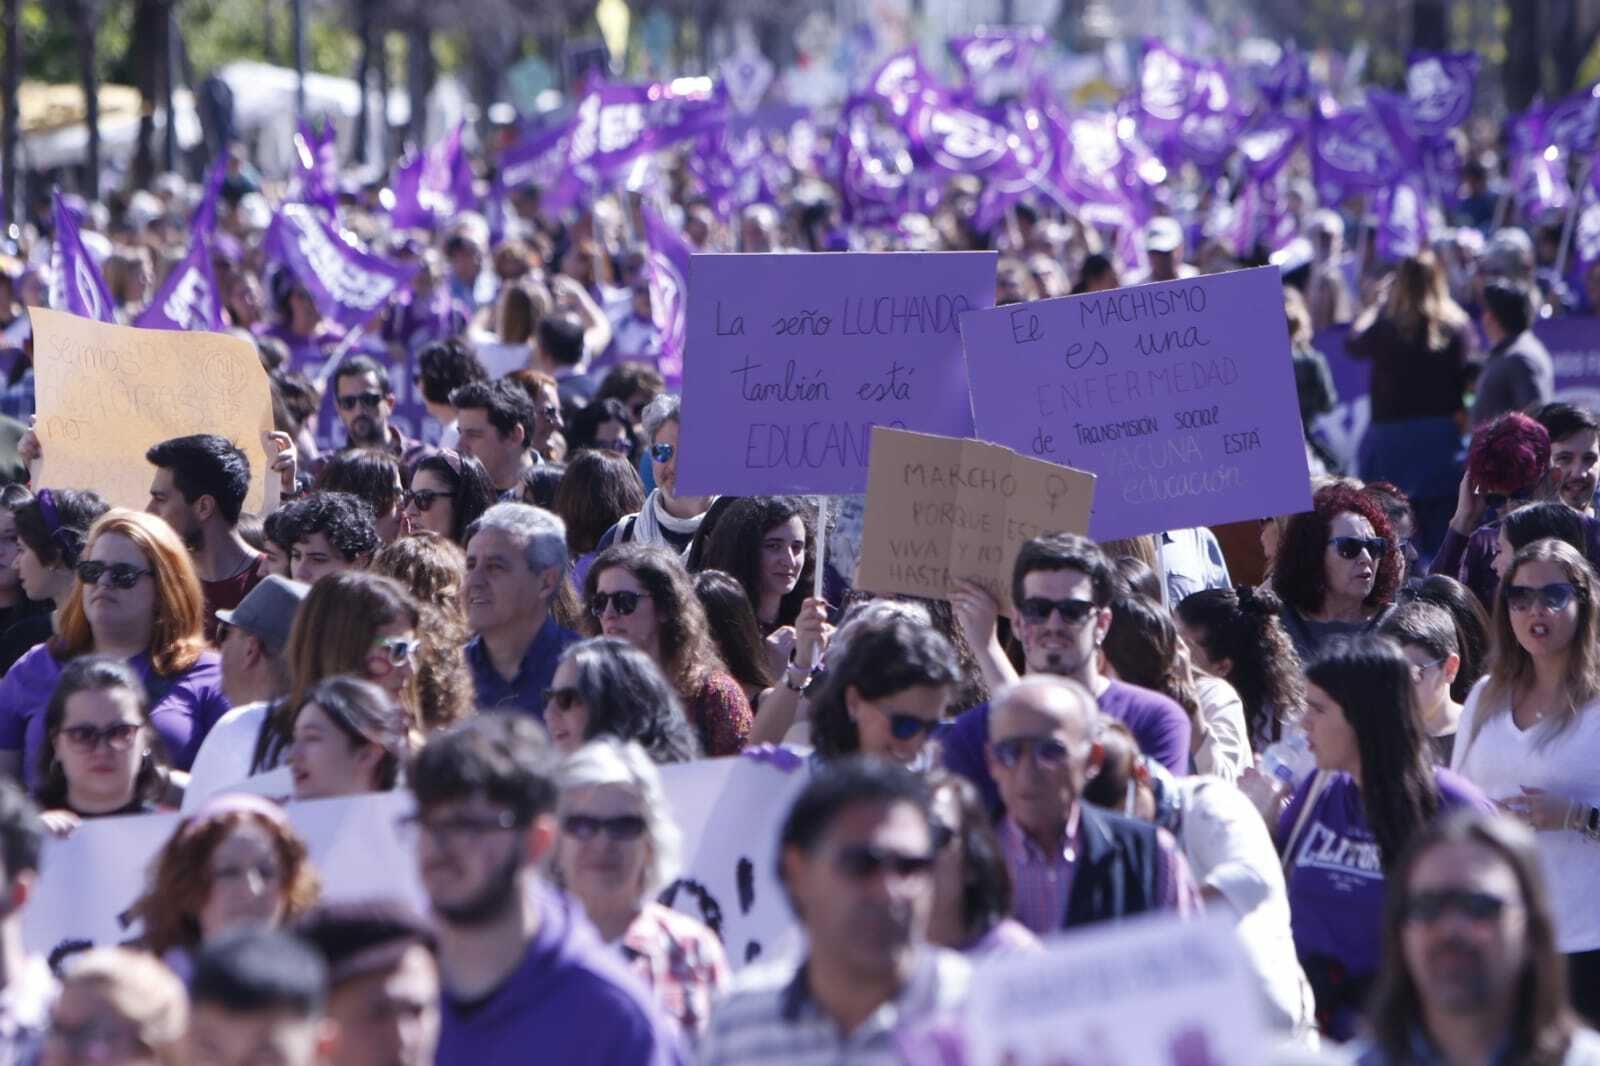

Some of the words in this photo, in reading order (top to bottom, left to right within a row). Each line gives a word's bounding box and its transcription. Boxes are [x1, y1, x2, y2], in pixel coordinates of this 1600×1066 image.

[715, 301, 745, 336] La
[771, 308, 833, 336] seño
[1079, 286, 1207, 328] MACHISMO
[1065, 340, 1110, 369] es
[1134, 325, 1211, 356] una
[730, 354, 831, 402] también
[856, 360, 916, 401] está
[1035, 355, 1239, 417] ENFERMEDAD
[744, 420, 906, 469] EDUCAN
[1031, 426, 1057, 455] de
[903, 463, 1018, 498] MARCHO
[912, 500, 993, 533] PORQUE
[889, 538, 938, 560] VIVA
